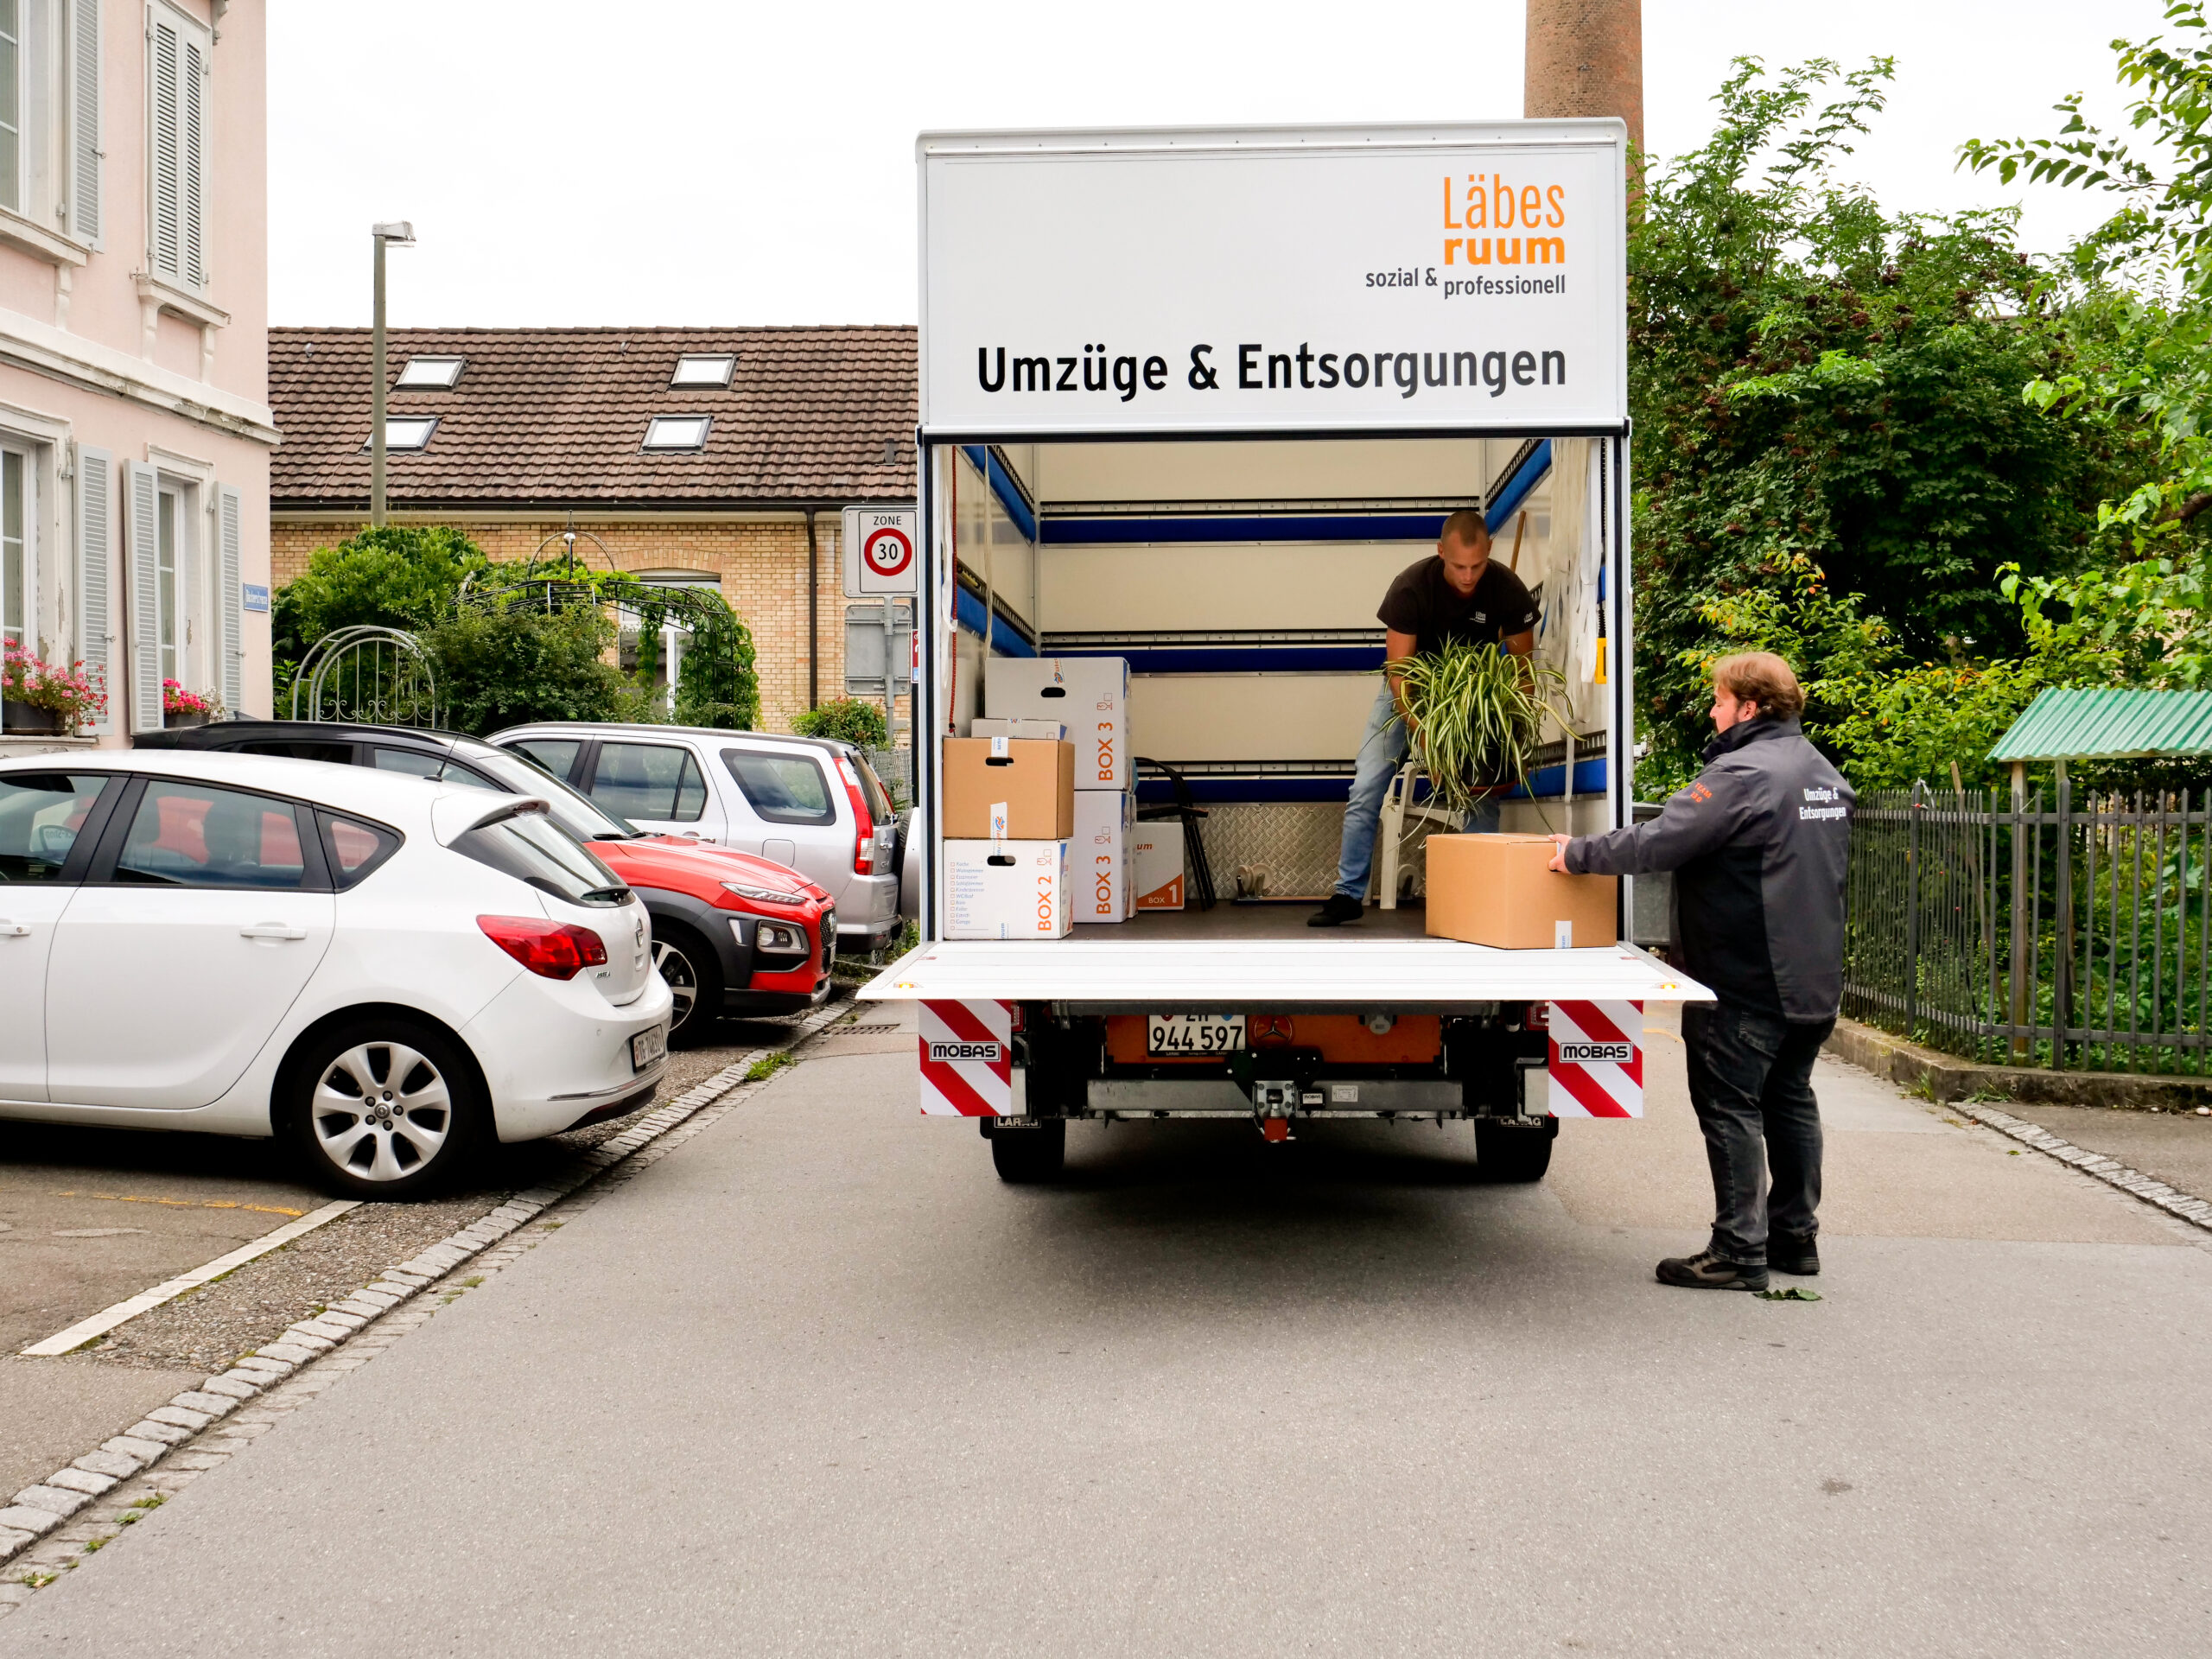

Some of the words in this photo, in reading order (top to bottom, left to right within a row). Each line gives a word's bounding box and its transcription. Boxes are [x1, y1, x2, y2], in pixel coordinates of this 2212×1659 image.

[1444, 173, 1566, 229] Läbes
[1444, 235, 1566, 265] ruum
[1365, 268, 1419, 288] sozial
[1424, 268, 1438, 287] &
[1444, 274, 1566, 300] professionell
[977, 343, 1168, 403] Umzüge
[1188, 343, 1219, 390] &
[1238, 341, 1567, 399] Entsorgungen
[873, 516, 901, 525] ZONE
[878, 543, 898, 560] 30
[1097, 721, 1113, 731] 3
[1097, 738, 1113, 780] BOX
[1803, 787, 1833, 803] Umzüge
[1833, 787, 1839, 800] &
[1799, 806, 1847, 821] Entsorgungen
[1096, 855, 1110, 865] 3
[1037, 875, 1052, 885] 2
[1096, 871, 1111, 914] BOX
[1168, 884, 1178, 903] 1
[1037, 891, 1052, 931] BOX
[1153, 1026, 1193, 1051] 944
[1201, 1026, 1243, 1050] 597
[933, 1045, 997, 1058] MOBAS
[1563, 1046, 1628, 1058] MOBAS
